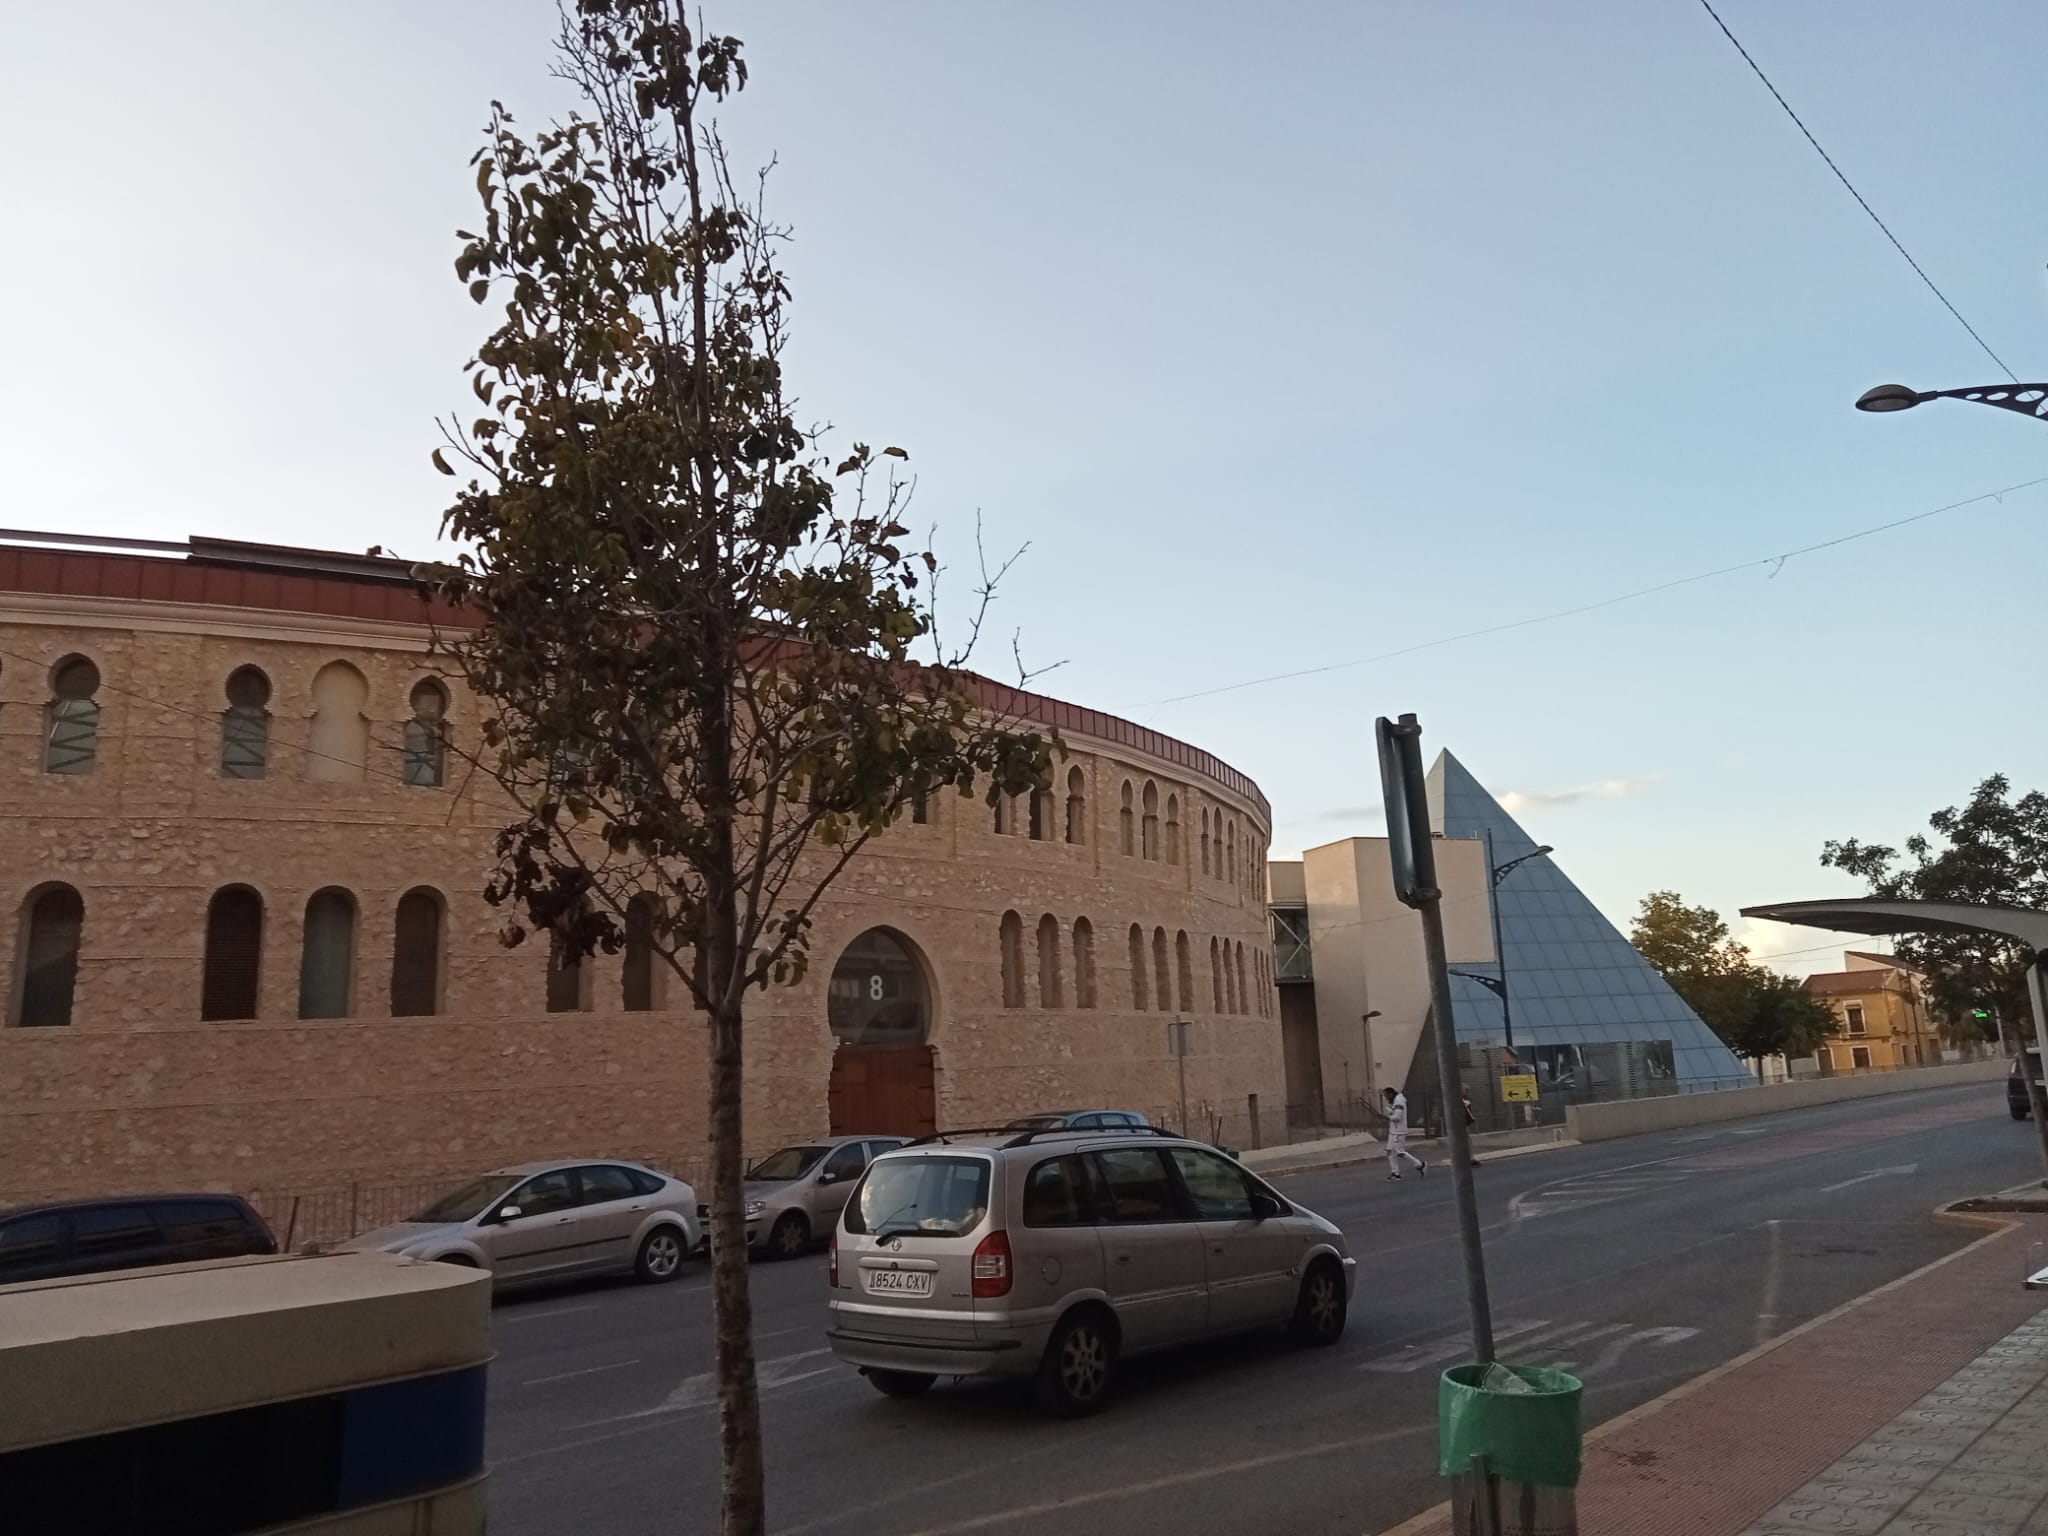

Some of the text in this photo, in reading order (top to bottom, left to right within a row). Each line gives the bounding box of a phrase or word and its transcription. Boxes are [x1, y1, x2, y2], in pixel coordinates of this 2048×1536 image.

[870, 975, 883, 1001] 8
[876, 1273, 928, 1290] 8524 CXV
